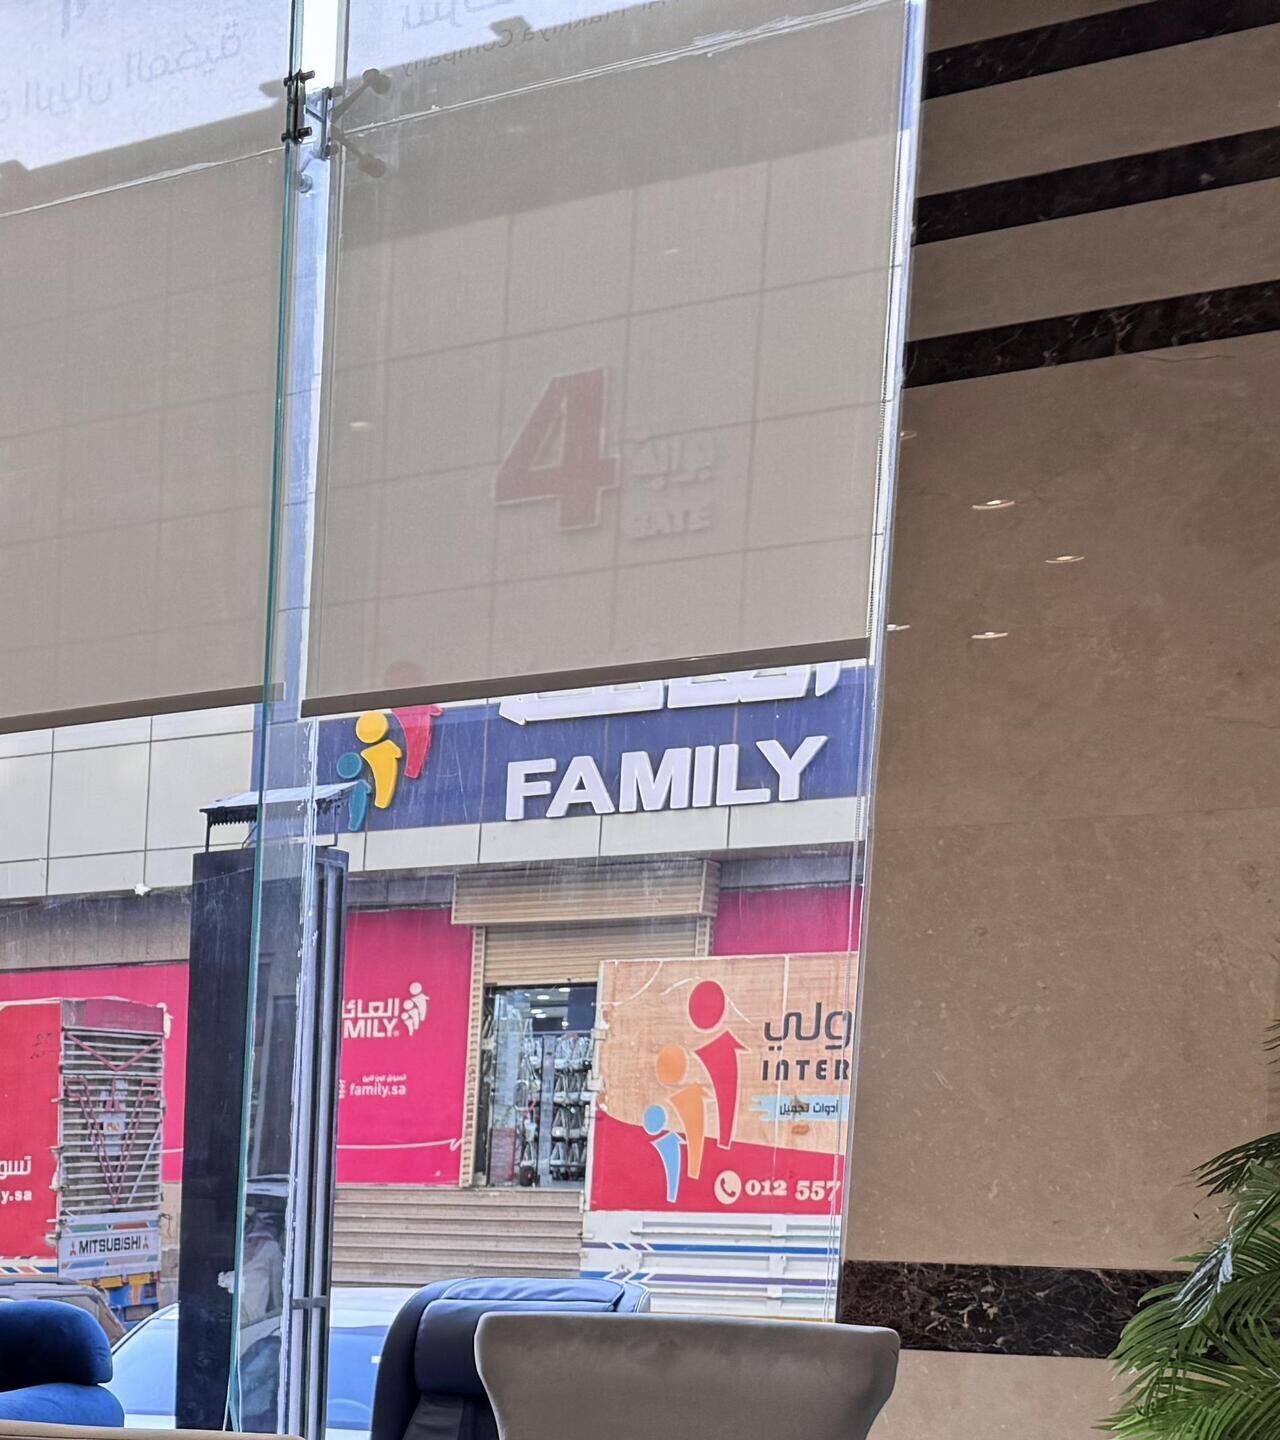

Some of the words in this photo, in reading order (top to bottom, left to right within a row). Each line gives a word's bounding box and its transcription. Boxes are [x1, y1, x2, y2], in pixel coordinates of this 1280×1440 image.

[490, 367, 622, 533] 4
[503, 734, 829, 822] FAMILY
[349, 1083, 407, 1098] family.sa
[744, 1178, 788, 1197] 012
[794, 1178, 842, 1202] 557
[78, 1234, 141, 1255] MITSUBISHI
